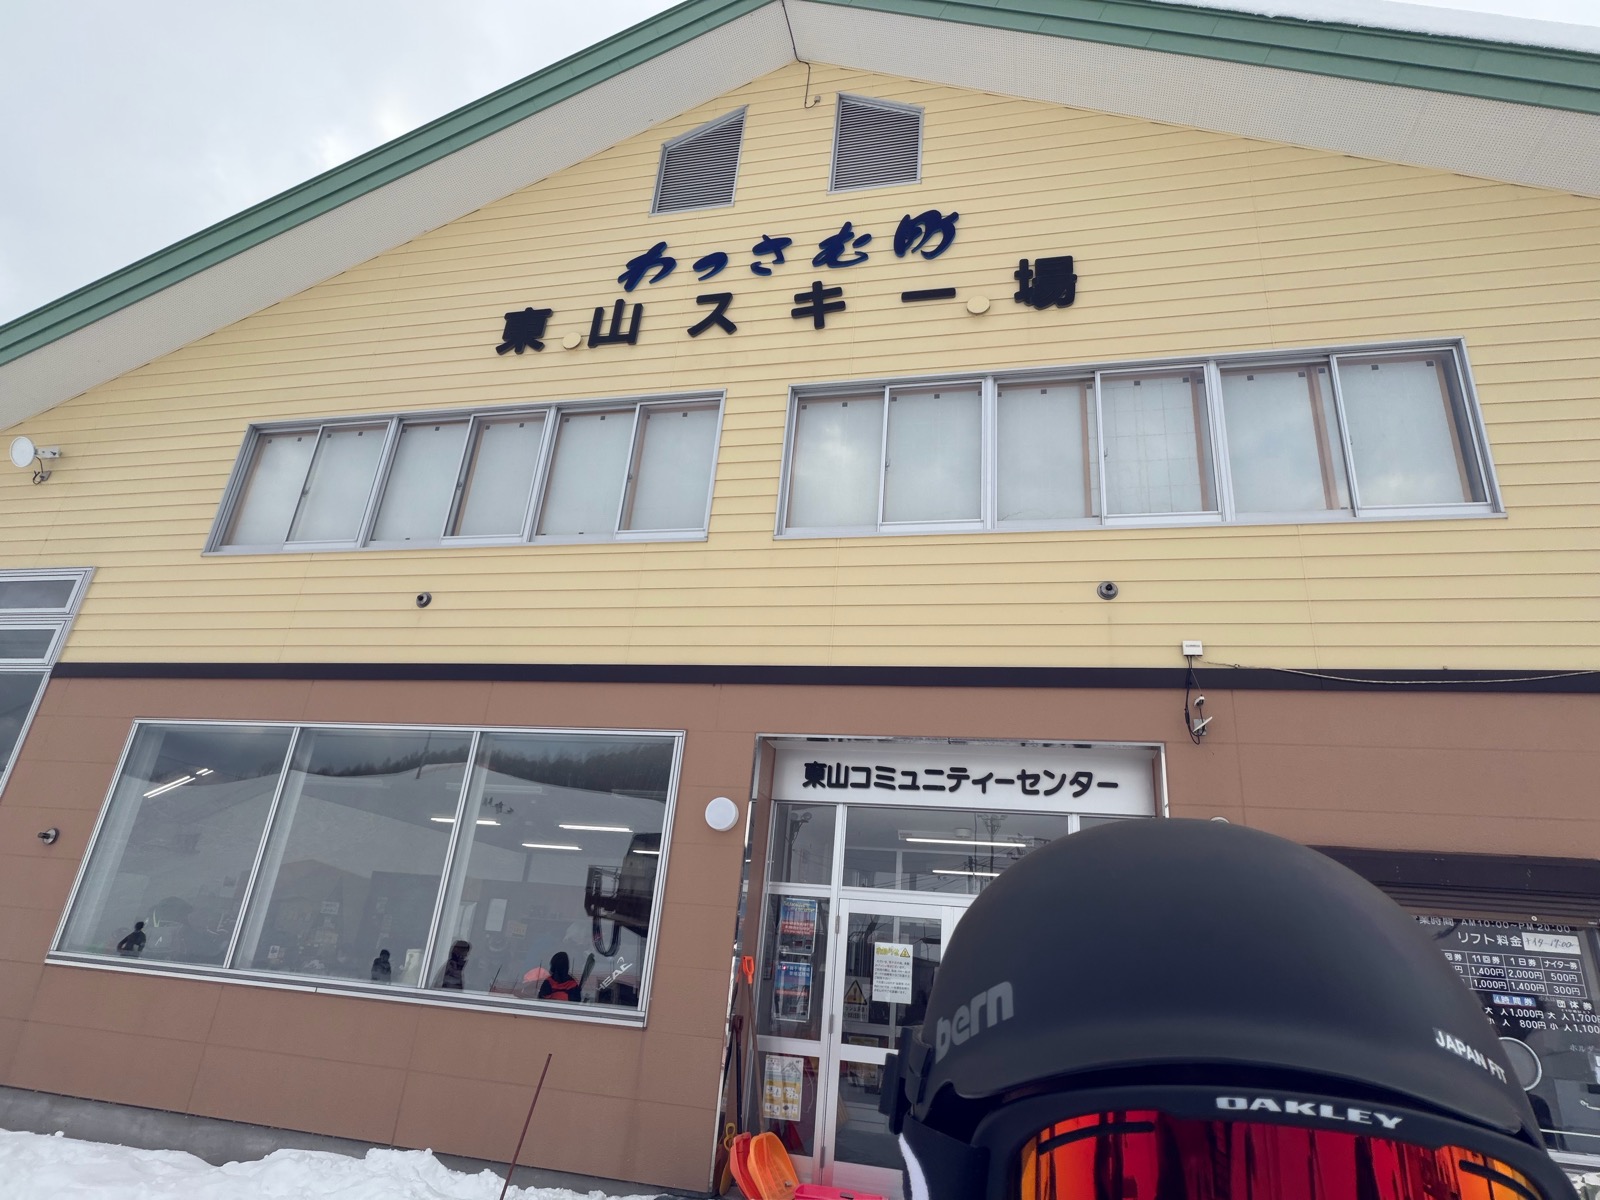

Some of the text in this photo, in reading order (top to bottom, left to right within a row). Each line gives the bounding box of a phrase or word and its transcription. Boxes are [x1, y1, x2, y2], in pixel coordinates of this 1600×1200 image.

[496, 255, 1077, 355] 東山スキー場
[802, 761, 1119, 798] 東山コミュニティーセンター
[1458, 931, 1522, 948] リフト料金
[1472, 954, 1500, 965] 11回券
[1544, 960, 1578, 970] ナイター券
[1551, 973, 1578, 983] 500円
[1553, 985, 1581, 996] 300円
[1556, 999, 1592, 1011] 団体券
[935, 981, 1014, 1064] bern
[1435, 1030, 1507, 1084] JAPAN FIT
[1216, 1096, 1402, 1129] OAKLEY
